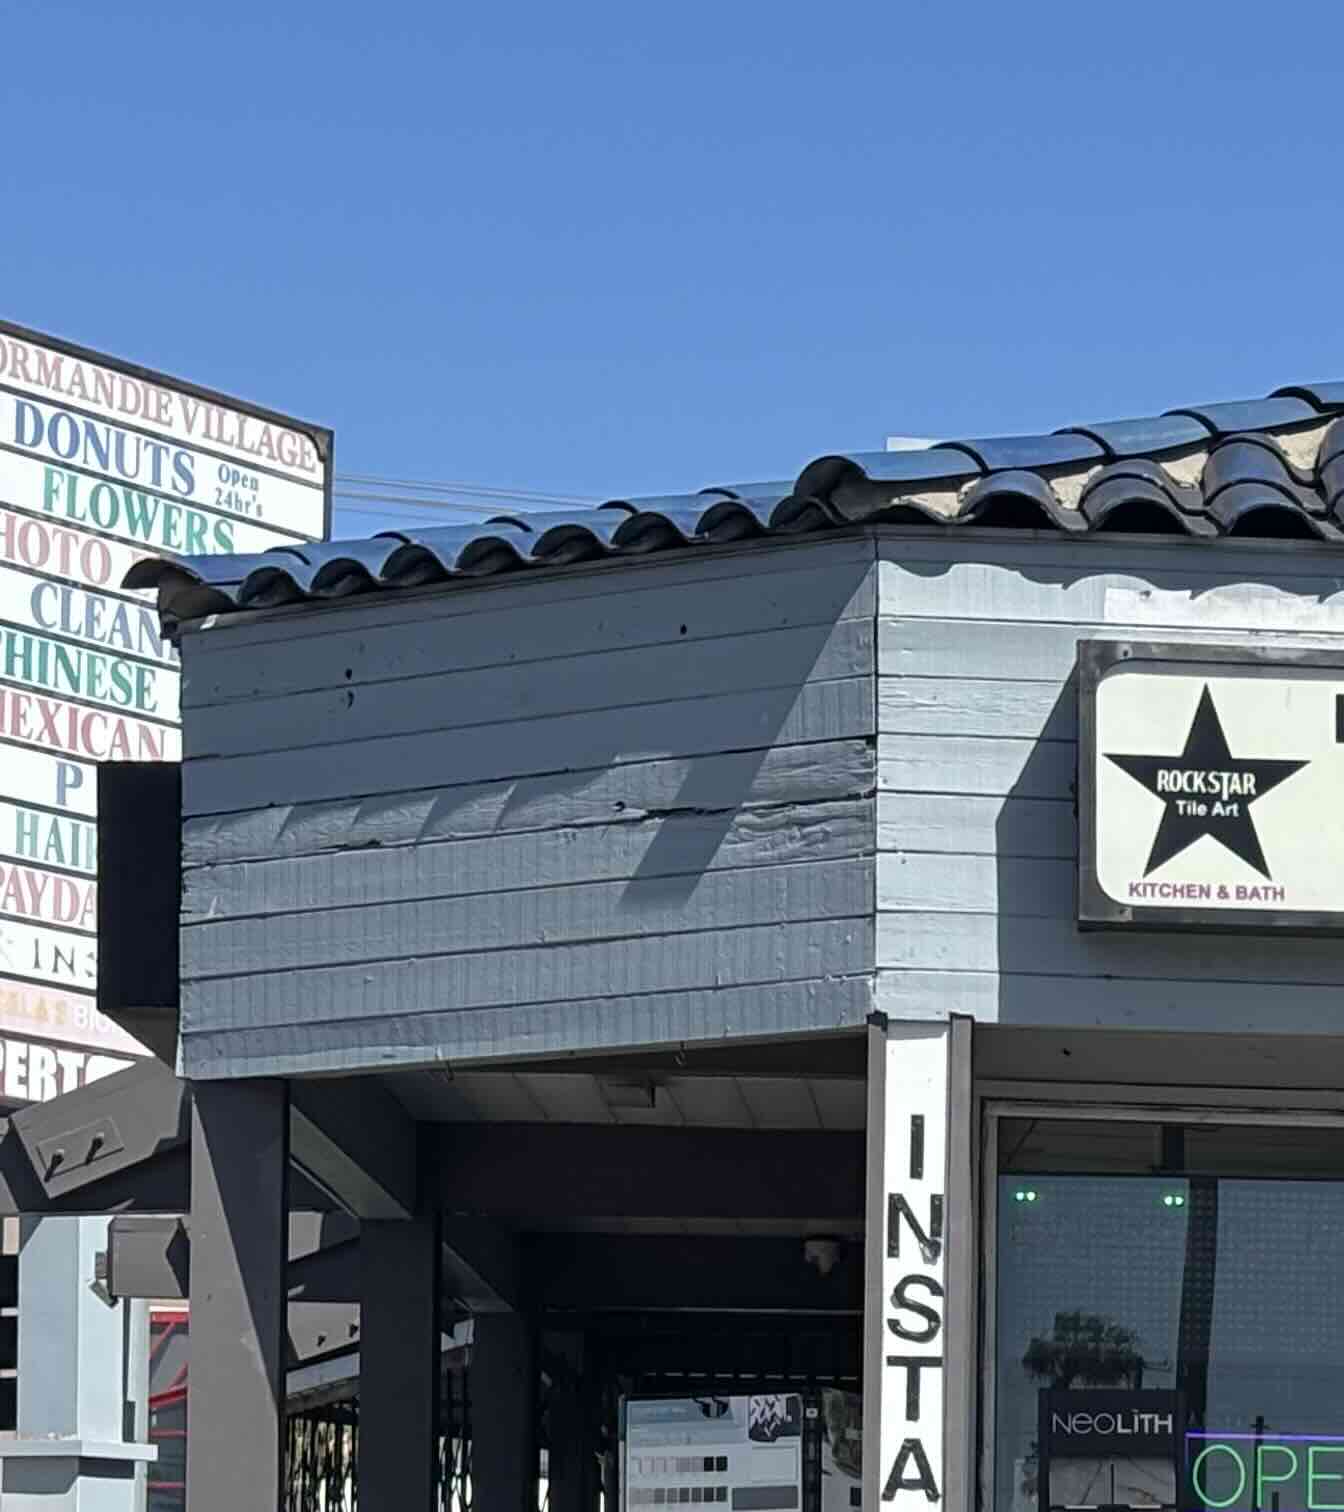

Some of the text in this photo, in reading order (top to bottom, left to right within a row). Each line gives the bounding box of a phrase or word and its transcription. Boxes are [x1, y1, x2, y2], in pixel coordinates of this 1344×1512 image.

[14, 399, 196, 497] DONUTS
[178, 395, 317, 474] VILLAGE
[43, 466, 234, 554] FLOWERS
[215, 487, 263, 517] 24hr's
[218, 464, 259, 491] Open
[31, 582, 180, 662] CLEAN
[0, 628, 157, 713] HINESE
[0, 691, 165, 763] EXICAN
[1157, 769, 1257, 801] ROCKSTAR
[1176, 800, 1240, 817] Tile Art
[0, 865, 97, 926] AYDA
[1128, 882, 1286, 902] KITCHEN & BATH
